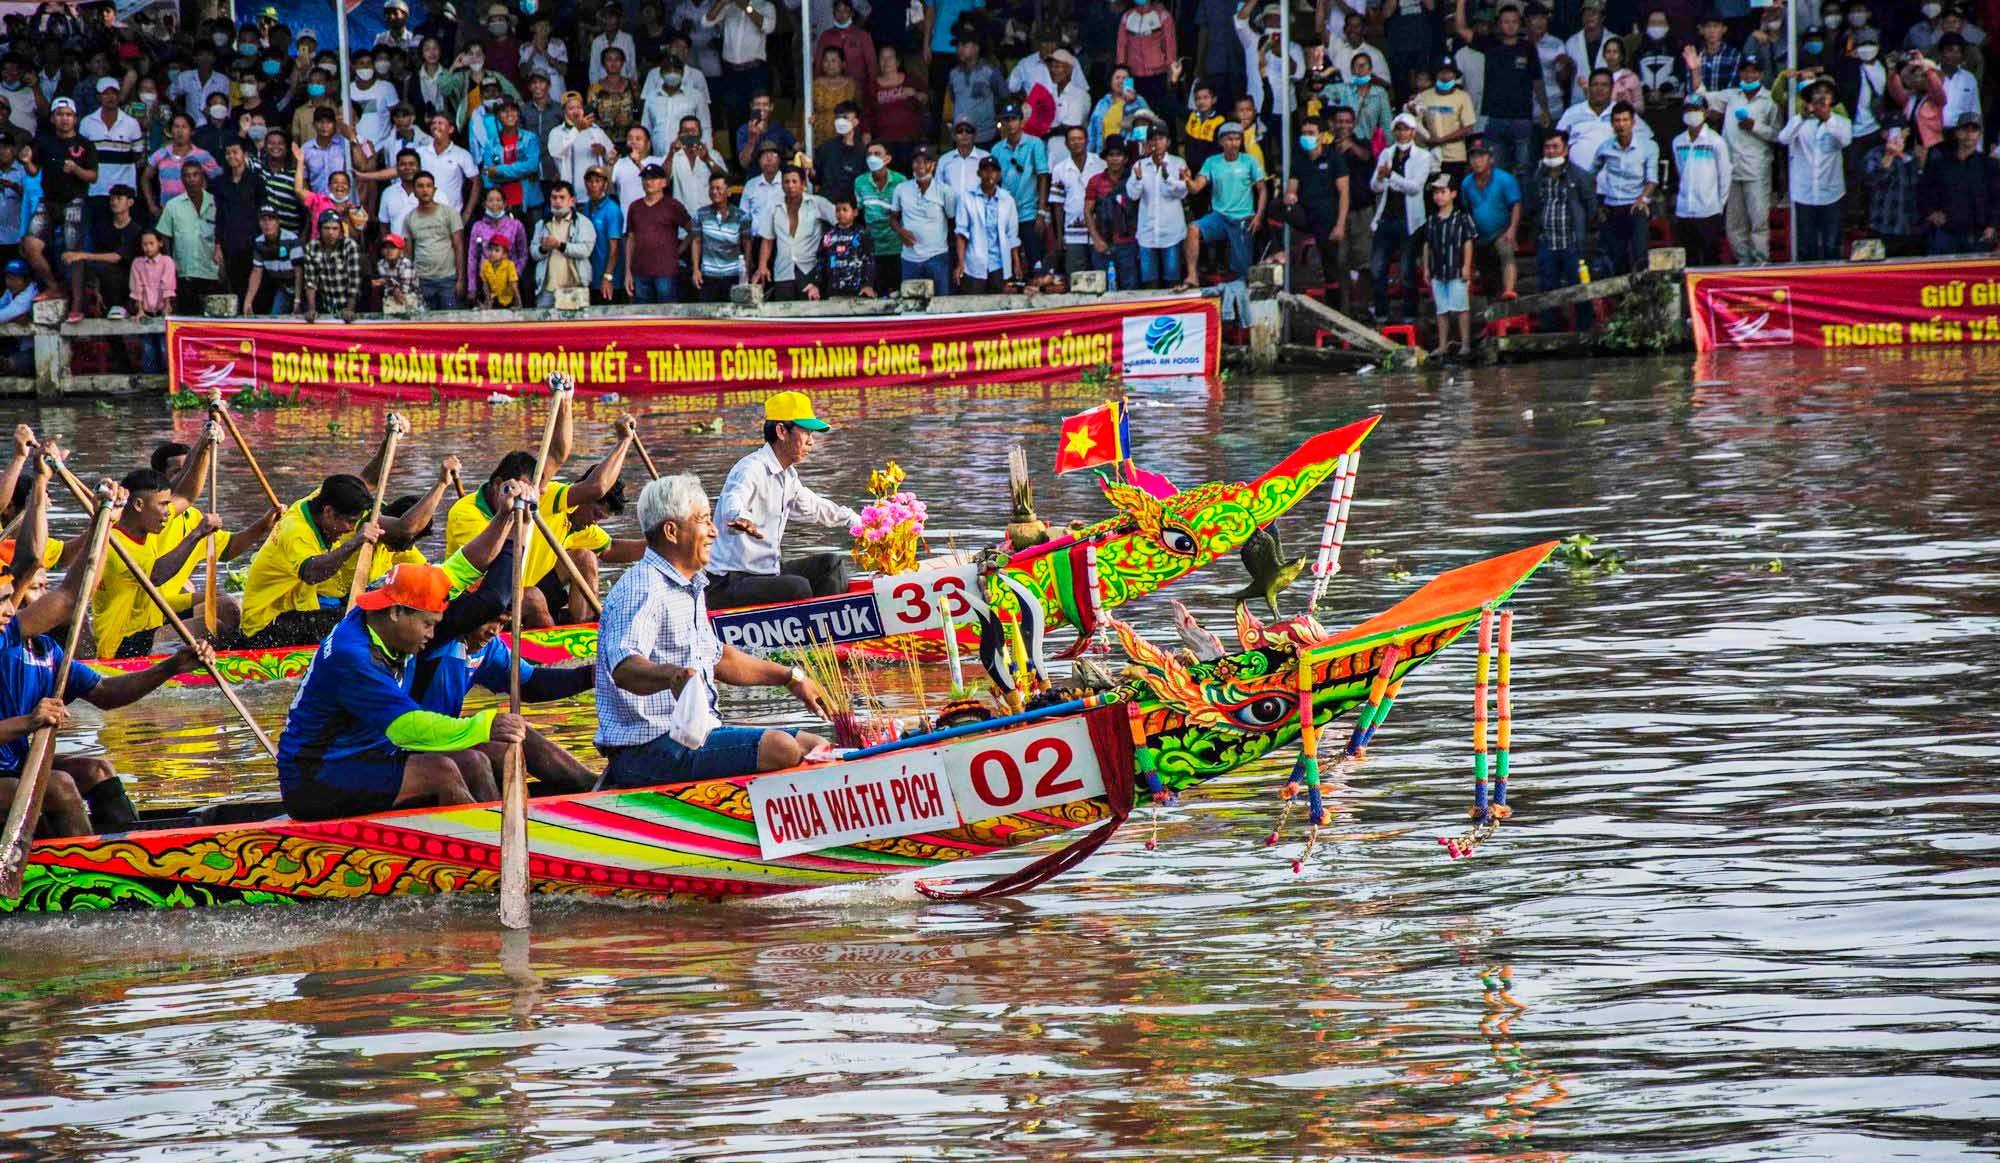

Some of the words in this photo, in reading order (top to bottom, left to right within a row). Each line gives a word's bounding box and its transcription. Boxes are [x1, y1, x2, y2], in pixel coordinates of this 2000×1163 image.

[1971, 278, 2000, 307] GÌ
[1820, 322, 1903, 347] TRONG
[271, 345, 329, 384] ĐOÀN
[334, 343, 375, 388] KẾT,
[379, 345, 438, 384] ĐOÀN
[441, 343, 484, 388] KẾT,
[488, 351, 523, 391] ĐẠI
[528, 344, 585, 384] ĐOÀN
[590, 340, 628, 384] KẾT
[646, 343, 716, 383] THÀNH
[720, 341, 783, 384] CÔNG,
[788, 339, 858, 379] THÀNH
[863, 338, 927, 378] CÔNG,
[930, 342, 968, 379] ĐẠI
[973, 332, 1042, 372] THÀNH
[1047, 329, 1113, 367] CÔNG!
[1173, 356, 1200, 365] FOODS
[893, 576, 971, 624] 33
[722, 615, 805, 648] PONG
[969, 737, 1084, 808] 02
[764, 783, 827, 845] CHÙA
[823, 774, 892, 834] WÁTH
[891, 765, 945, 823] PÍCH
